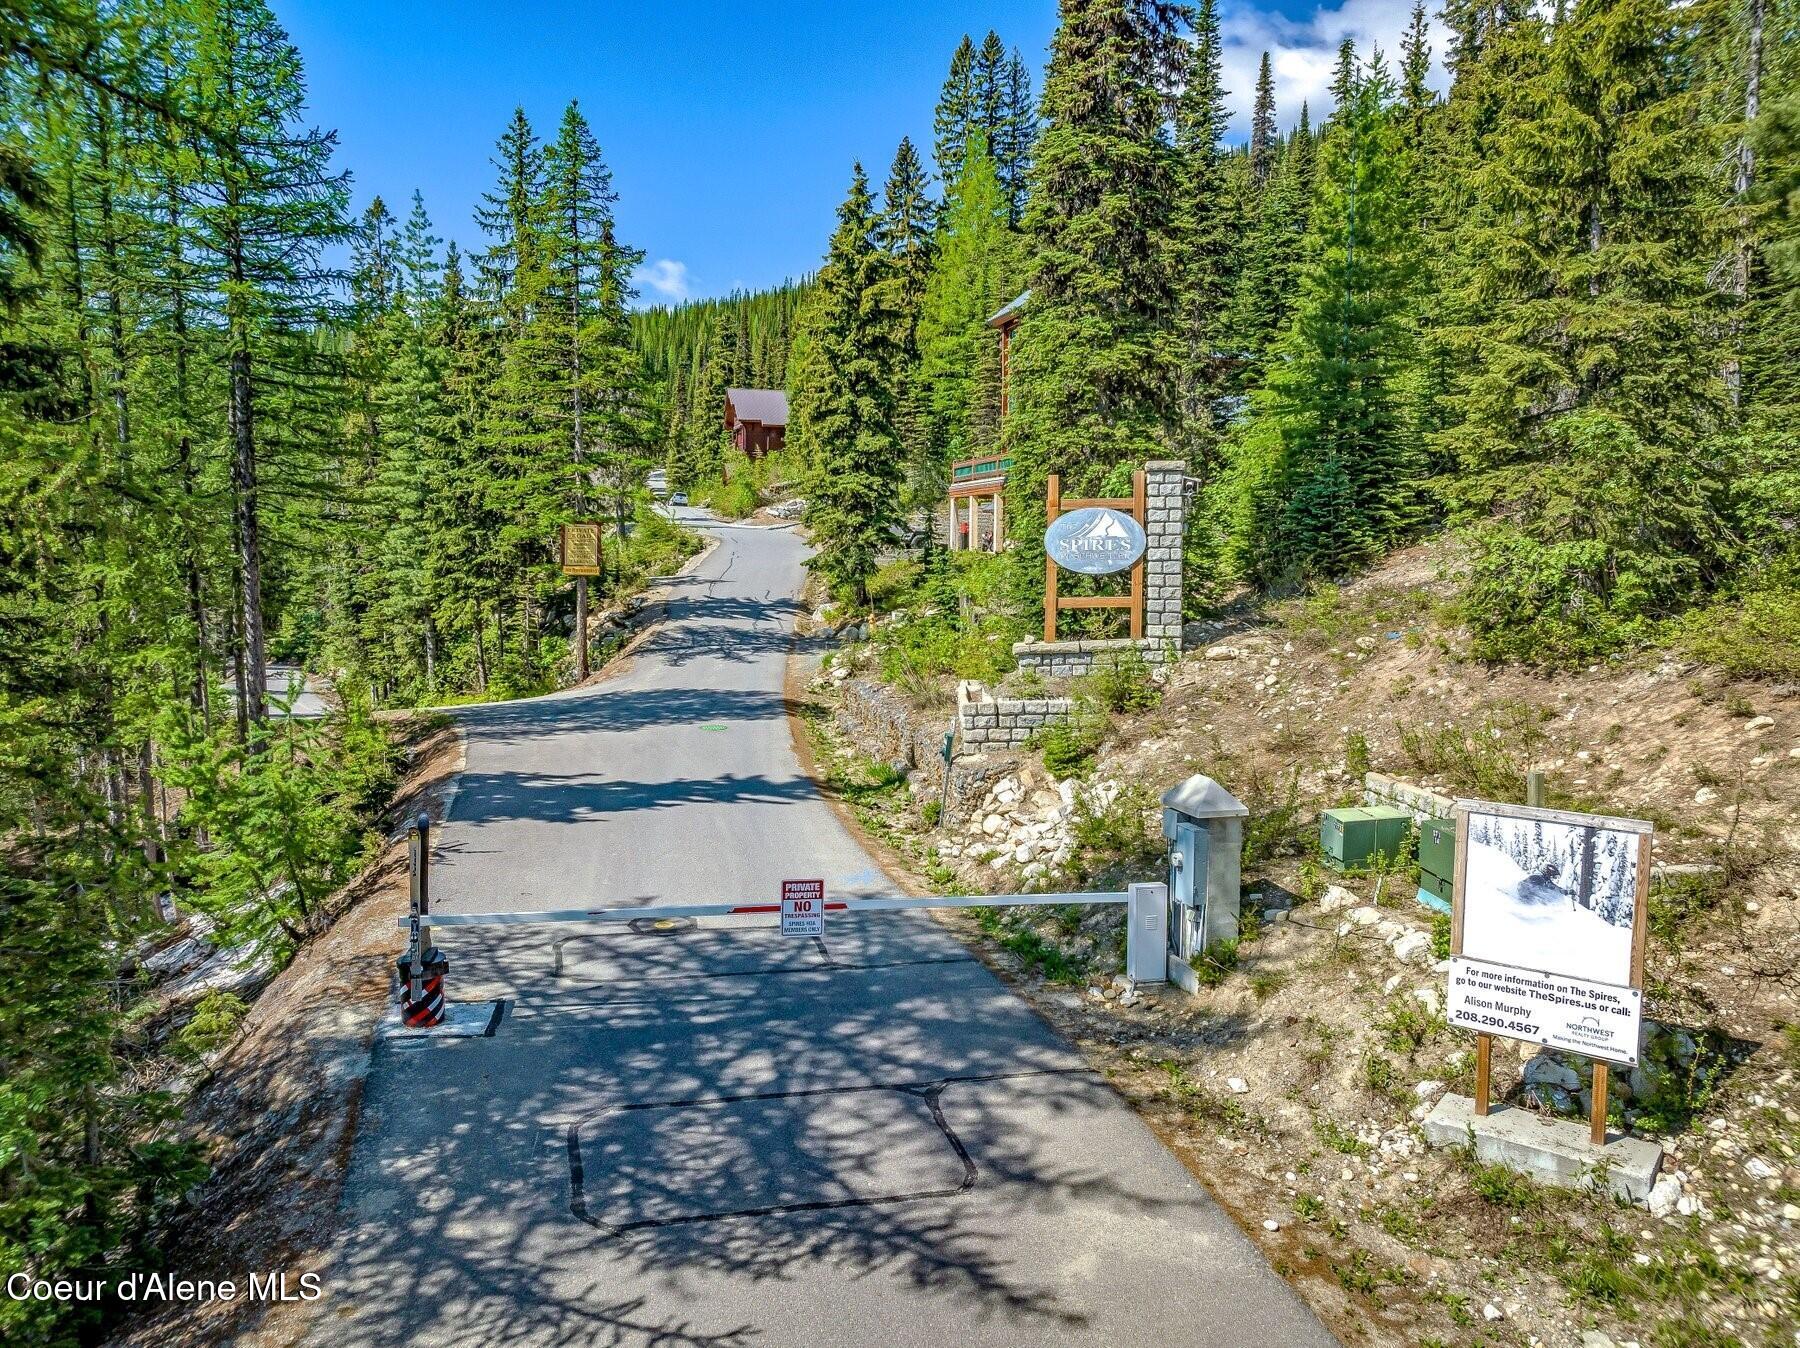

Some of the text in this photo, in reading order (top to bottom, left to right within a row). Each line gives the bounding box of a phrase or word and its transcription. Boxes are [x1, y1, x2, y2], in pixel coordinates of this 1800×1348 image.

[1059, 538, 1131, 551] SPIRES
[784, 891, 820, 899] PROPERTY
[785, 883, 820, 891] PRIVATE
[794, 901, 811, 912] NO
[1466, 966, 1620, 1005] For more information on The Spires,
[1455, 977, 1631, 1017] go to our website TheSpires.us or call:
[1464, 995, 1531, 1019] Alison Murphy
[1455, 1009, 1540, 1035] 208.290.4567
[1566, 1022, 1615, 1038] NORTHWEST
[1552, 1034, 1571, 1044] Making
[1582, 1040, 1609, 1051] Northwest
[1571, 1030, 1609, 1042] REALTY GROUP
